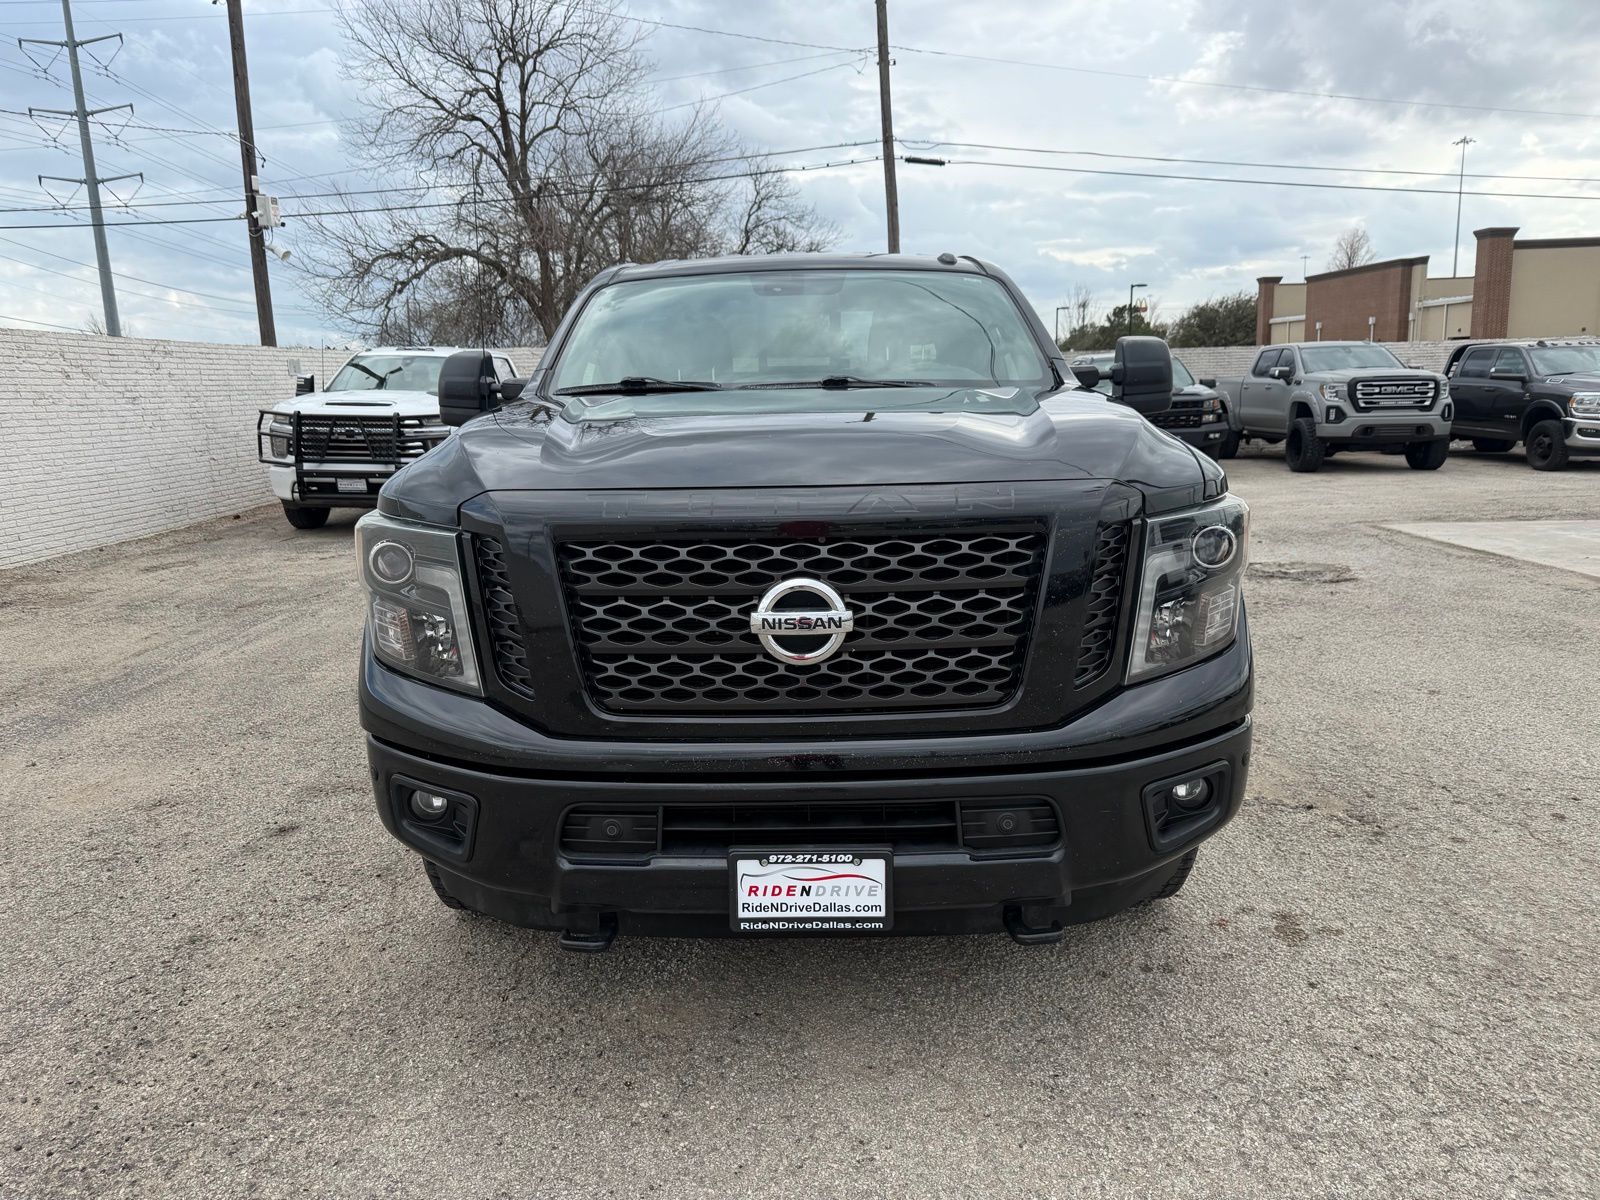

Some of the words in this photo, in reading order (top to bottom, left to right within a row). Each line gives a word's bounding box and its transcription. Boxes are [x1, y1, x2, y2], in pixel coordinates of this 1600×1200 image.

[761, 616, 842, 630] NISSAN
[768, 854, 853, 863] 972-271-5100
[741, 902, 882, 913] RideNDriveDallas.com
[740, 921, 883, 930] RideNDriveDallas.com
